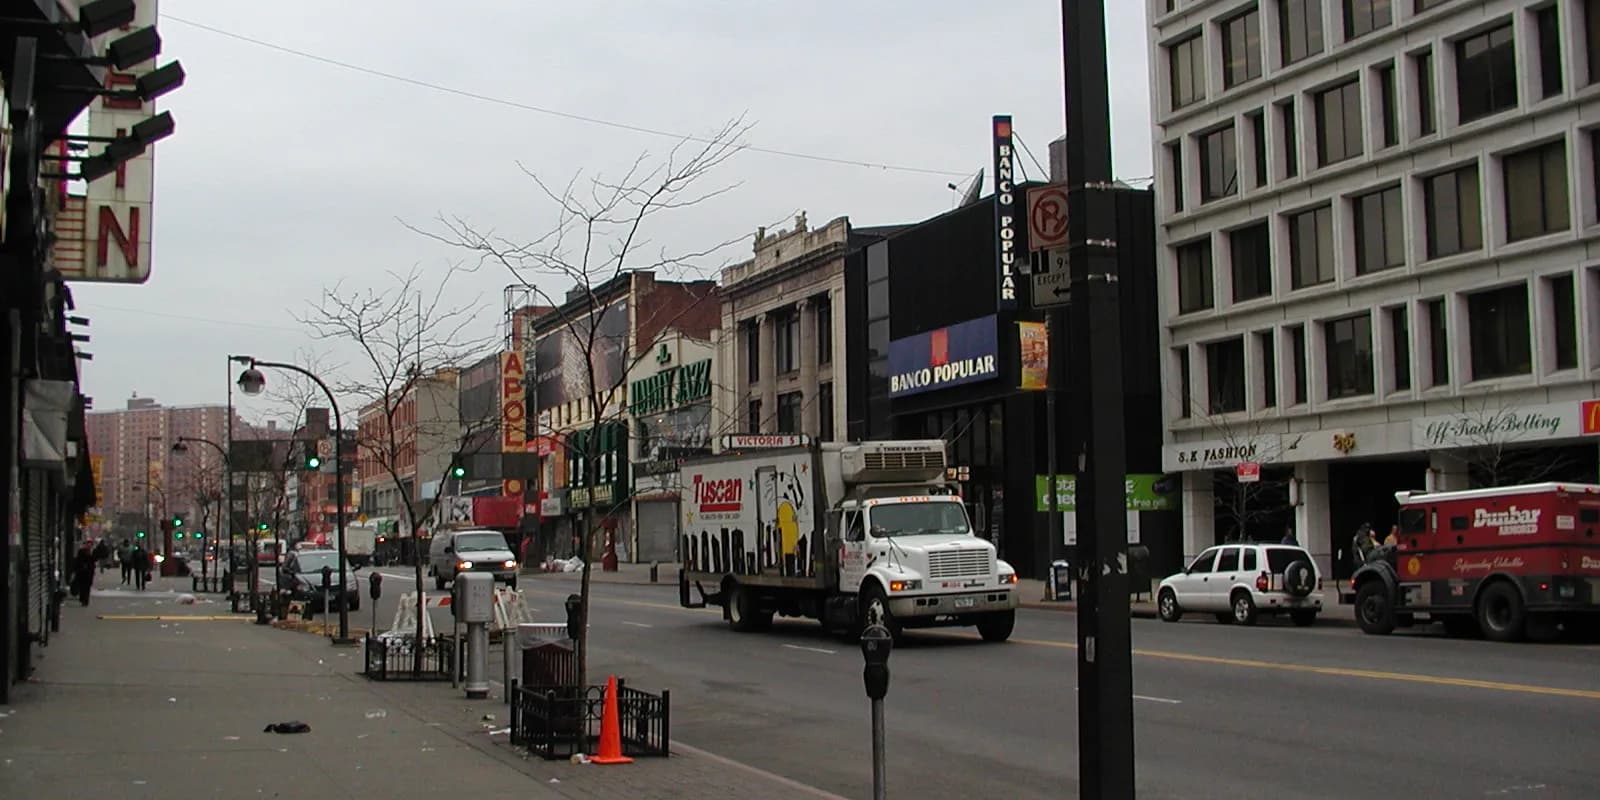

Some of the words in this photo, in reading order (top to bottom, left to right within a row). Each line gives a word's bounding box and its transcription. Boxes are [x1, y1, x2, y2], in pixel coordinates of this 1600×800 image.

[999, 144, 1013, 206] BANCO
[1000, 215, 1016, 300] POPULAR
[1036, 273, 1067, 286] EXCEPT
[675, 358, 713, 405] JAZZ
[890, 368, 931, 393] BANCO
[933, 354, 996, 384] POPULAR
[736, 435, 784, 446] VICTORIA
[1425, 415, 1498, 445] Off-Track
[1501, 412, 1563, 436] Betting
[1203, 444, 1257, 462] FASHION
[693, 474, 743, 504] Tuscan
[1473, 505, 1541, 528] Dunbar
